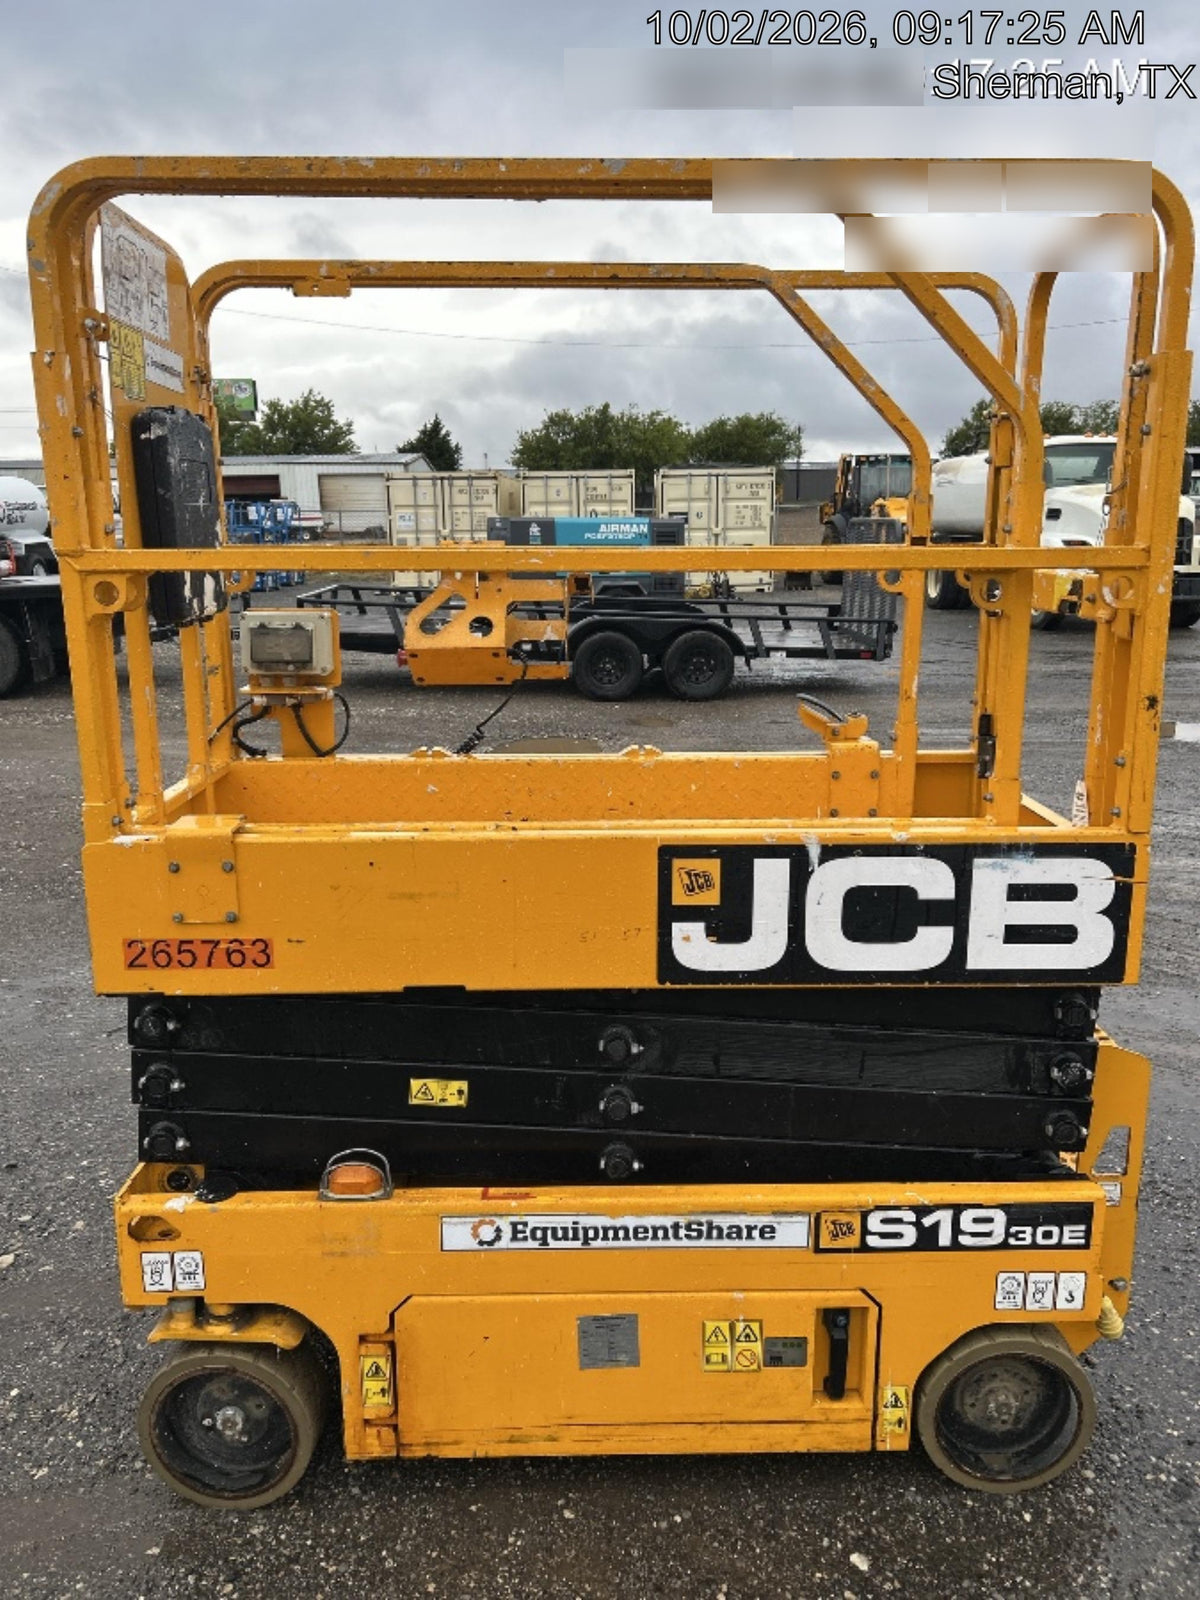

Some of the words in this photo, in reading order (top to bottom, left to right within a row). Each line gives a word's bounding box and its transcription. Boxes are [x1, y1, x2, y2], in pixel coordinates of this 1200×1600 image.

[599, 523, 649, 534] AIRMAN
[671, 856, 1115, 971] JCB
[127, 938, 271, 968] 265763
[509, 1221, 777, 1248] EquipmentShare
